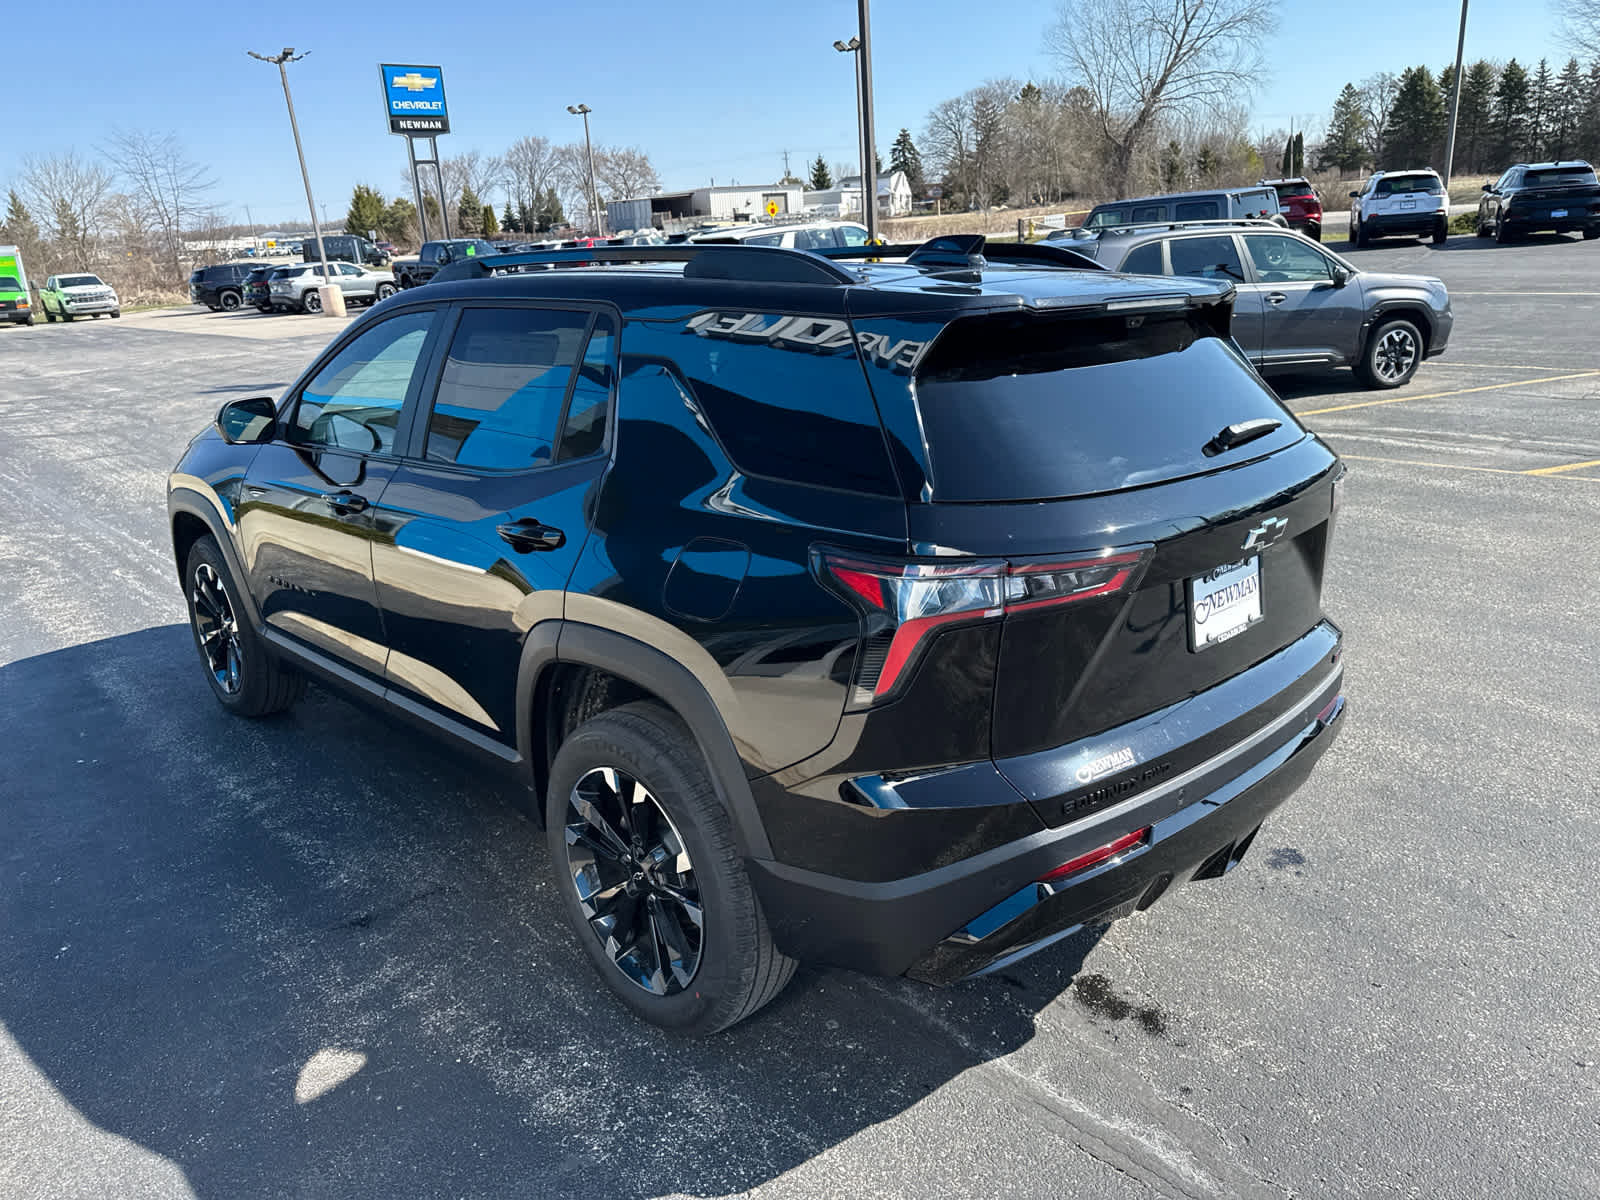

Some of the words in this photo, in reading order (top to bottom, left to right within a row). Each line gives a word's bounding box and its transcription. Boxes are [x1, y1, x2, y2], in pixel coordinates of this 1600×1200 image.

[392, 100, 442, 110] CHEVROLET
[400, 120, 442, 129] NEWMAN
[1195, 574, 1258, 625] NEWMAN
[1075, 747, 1134, 783] NEWMAN
